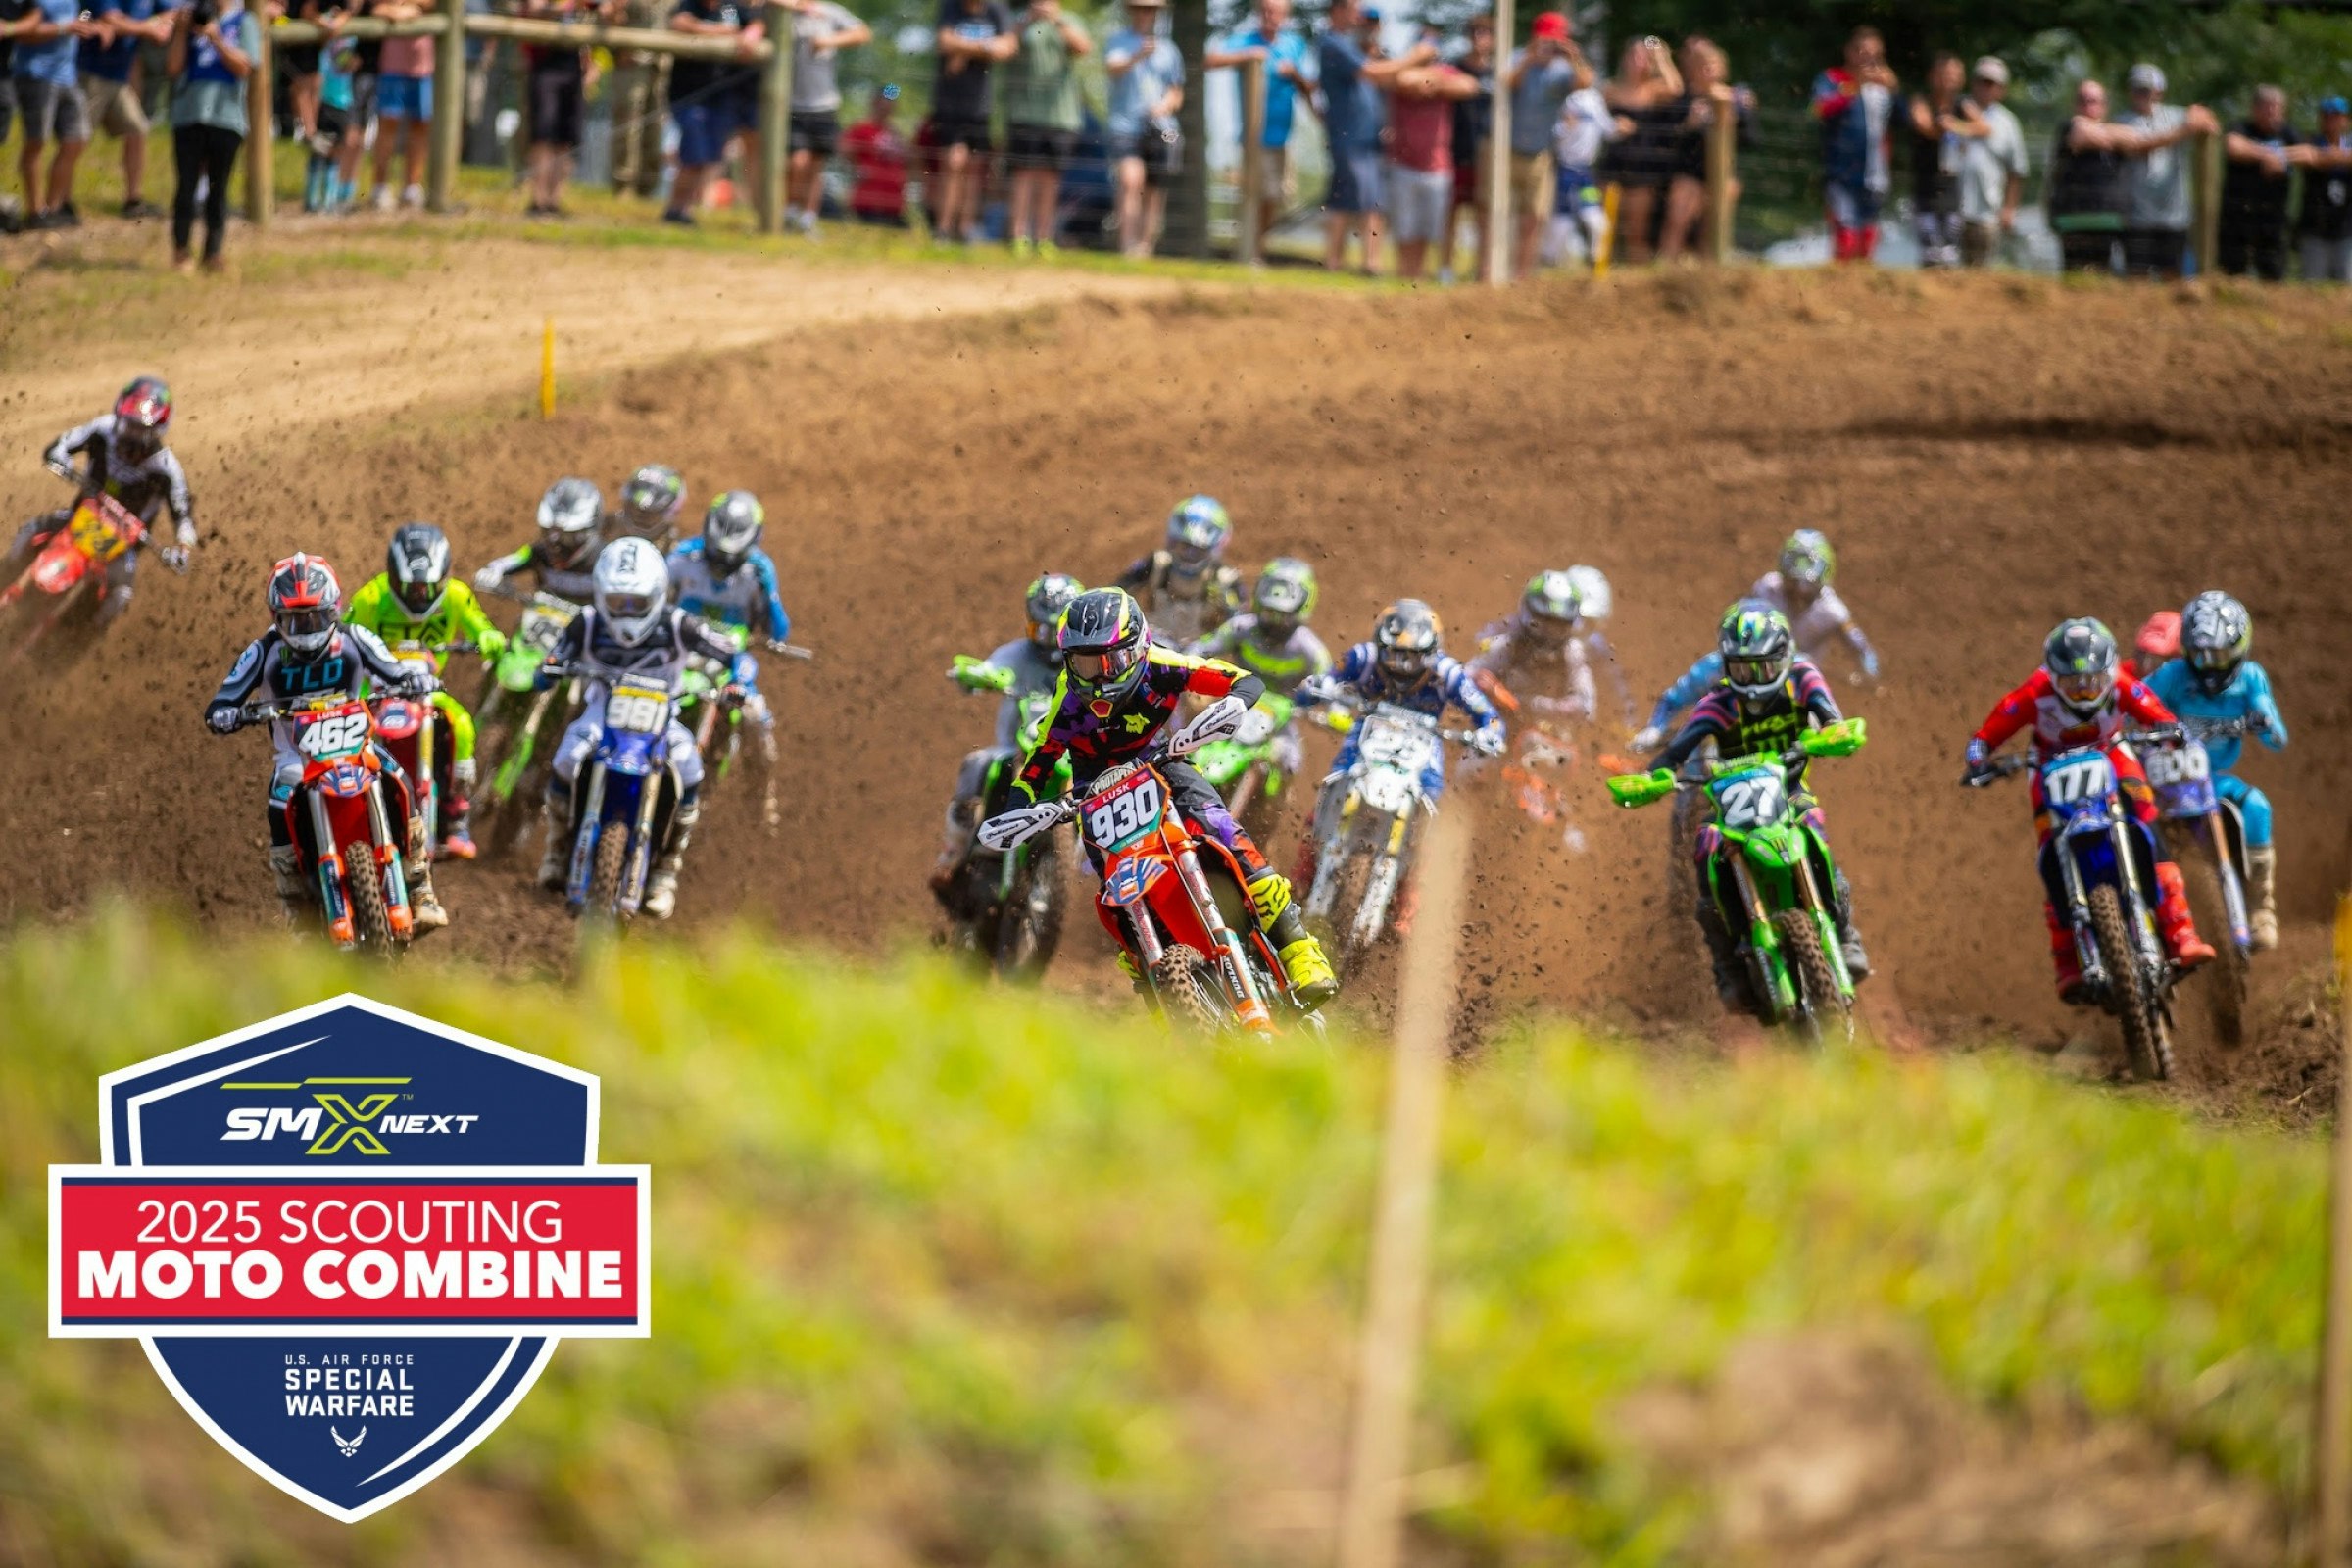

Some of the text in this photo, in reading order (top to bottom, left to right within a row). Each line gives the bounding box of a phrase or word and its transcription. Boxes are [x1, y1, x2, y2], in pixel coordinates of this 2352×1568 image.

[281, 658, 343, 690] TLD
[299, 712, 368, 757] 462
[1102, 782, 1130, 804] LUSK
[1721, 777, 1780, 827] 27
[2044, 758, 2107, 805] 177
[1091, 778, 1161, 849] 930
